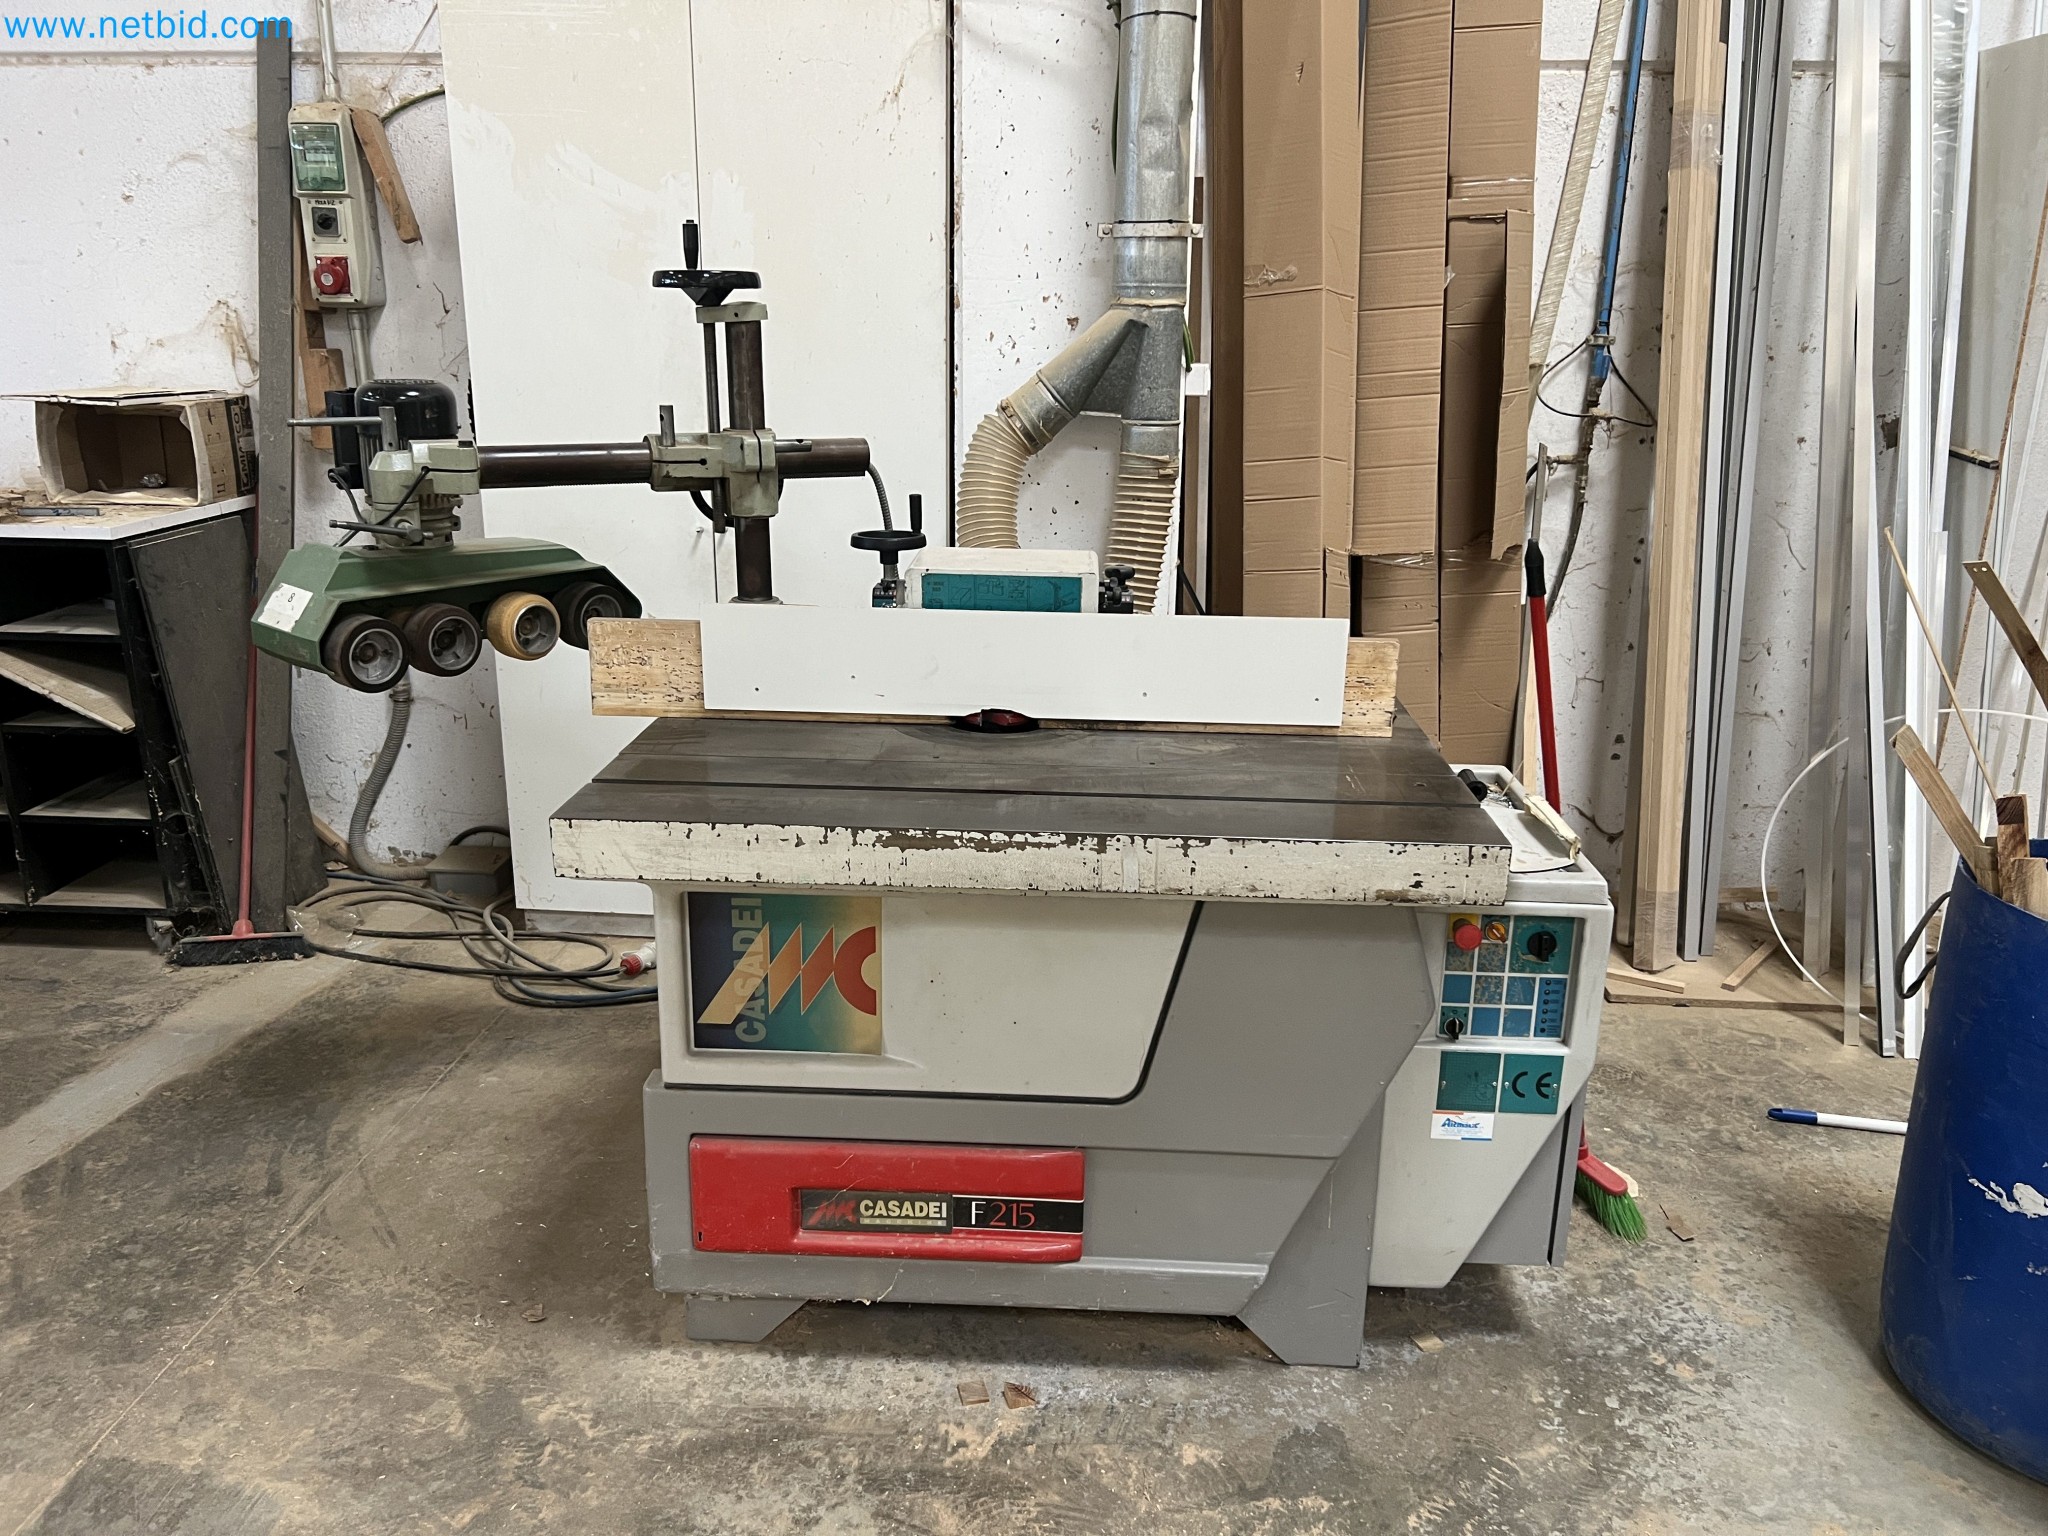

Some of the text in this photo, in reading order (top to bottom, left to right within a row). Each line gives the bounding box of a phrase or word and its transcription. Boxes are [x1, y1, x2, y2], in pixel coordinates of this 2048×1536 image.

[731, 897, 766, 1042] CASADEI
[1511, 1071, 1552, 1099] CE
[859, 1199, 947, 1218] CASADEI
[971, 1201, 1036, 1228] F 215
